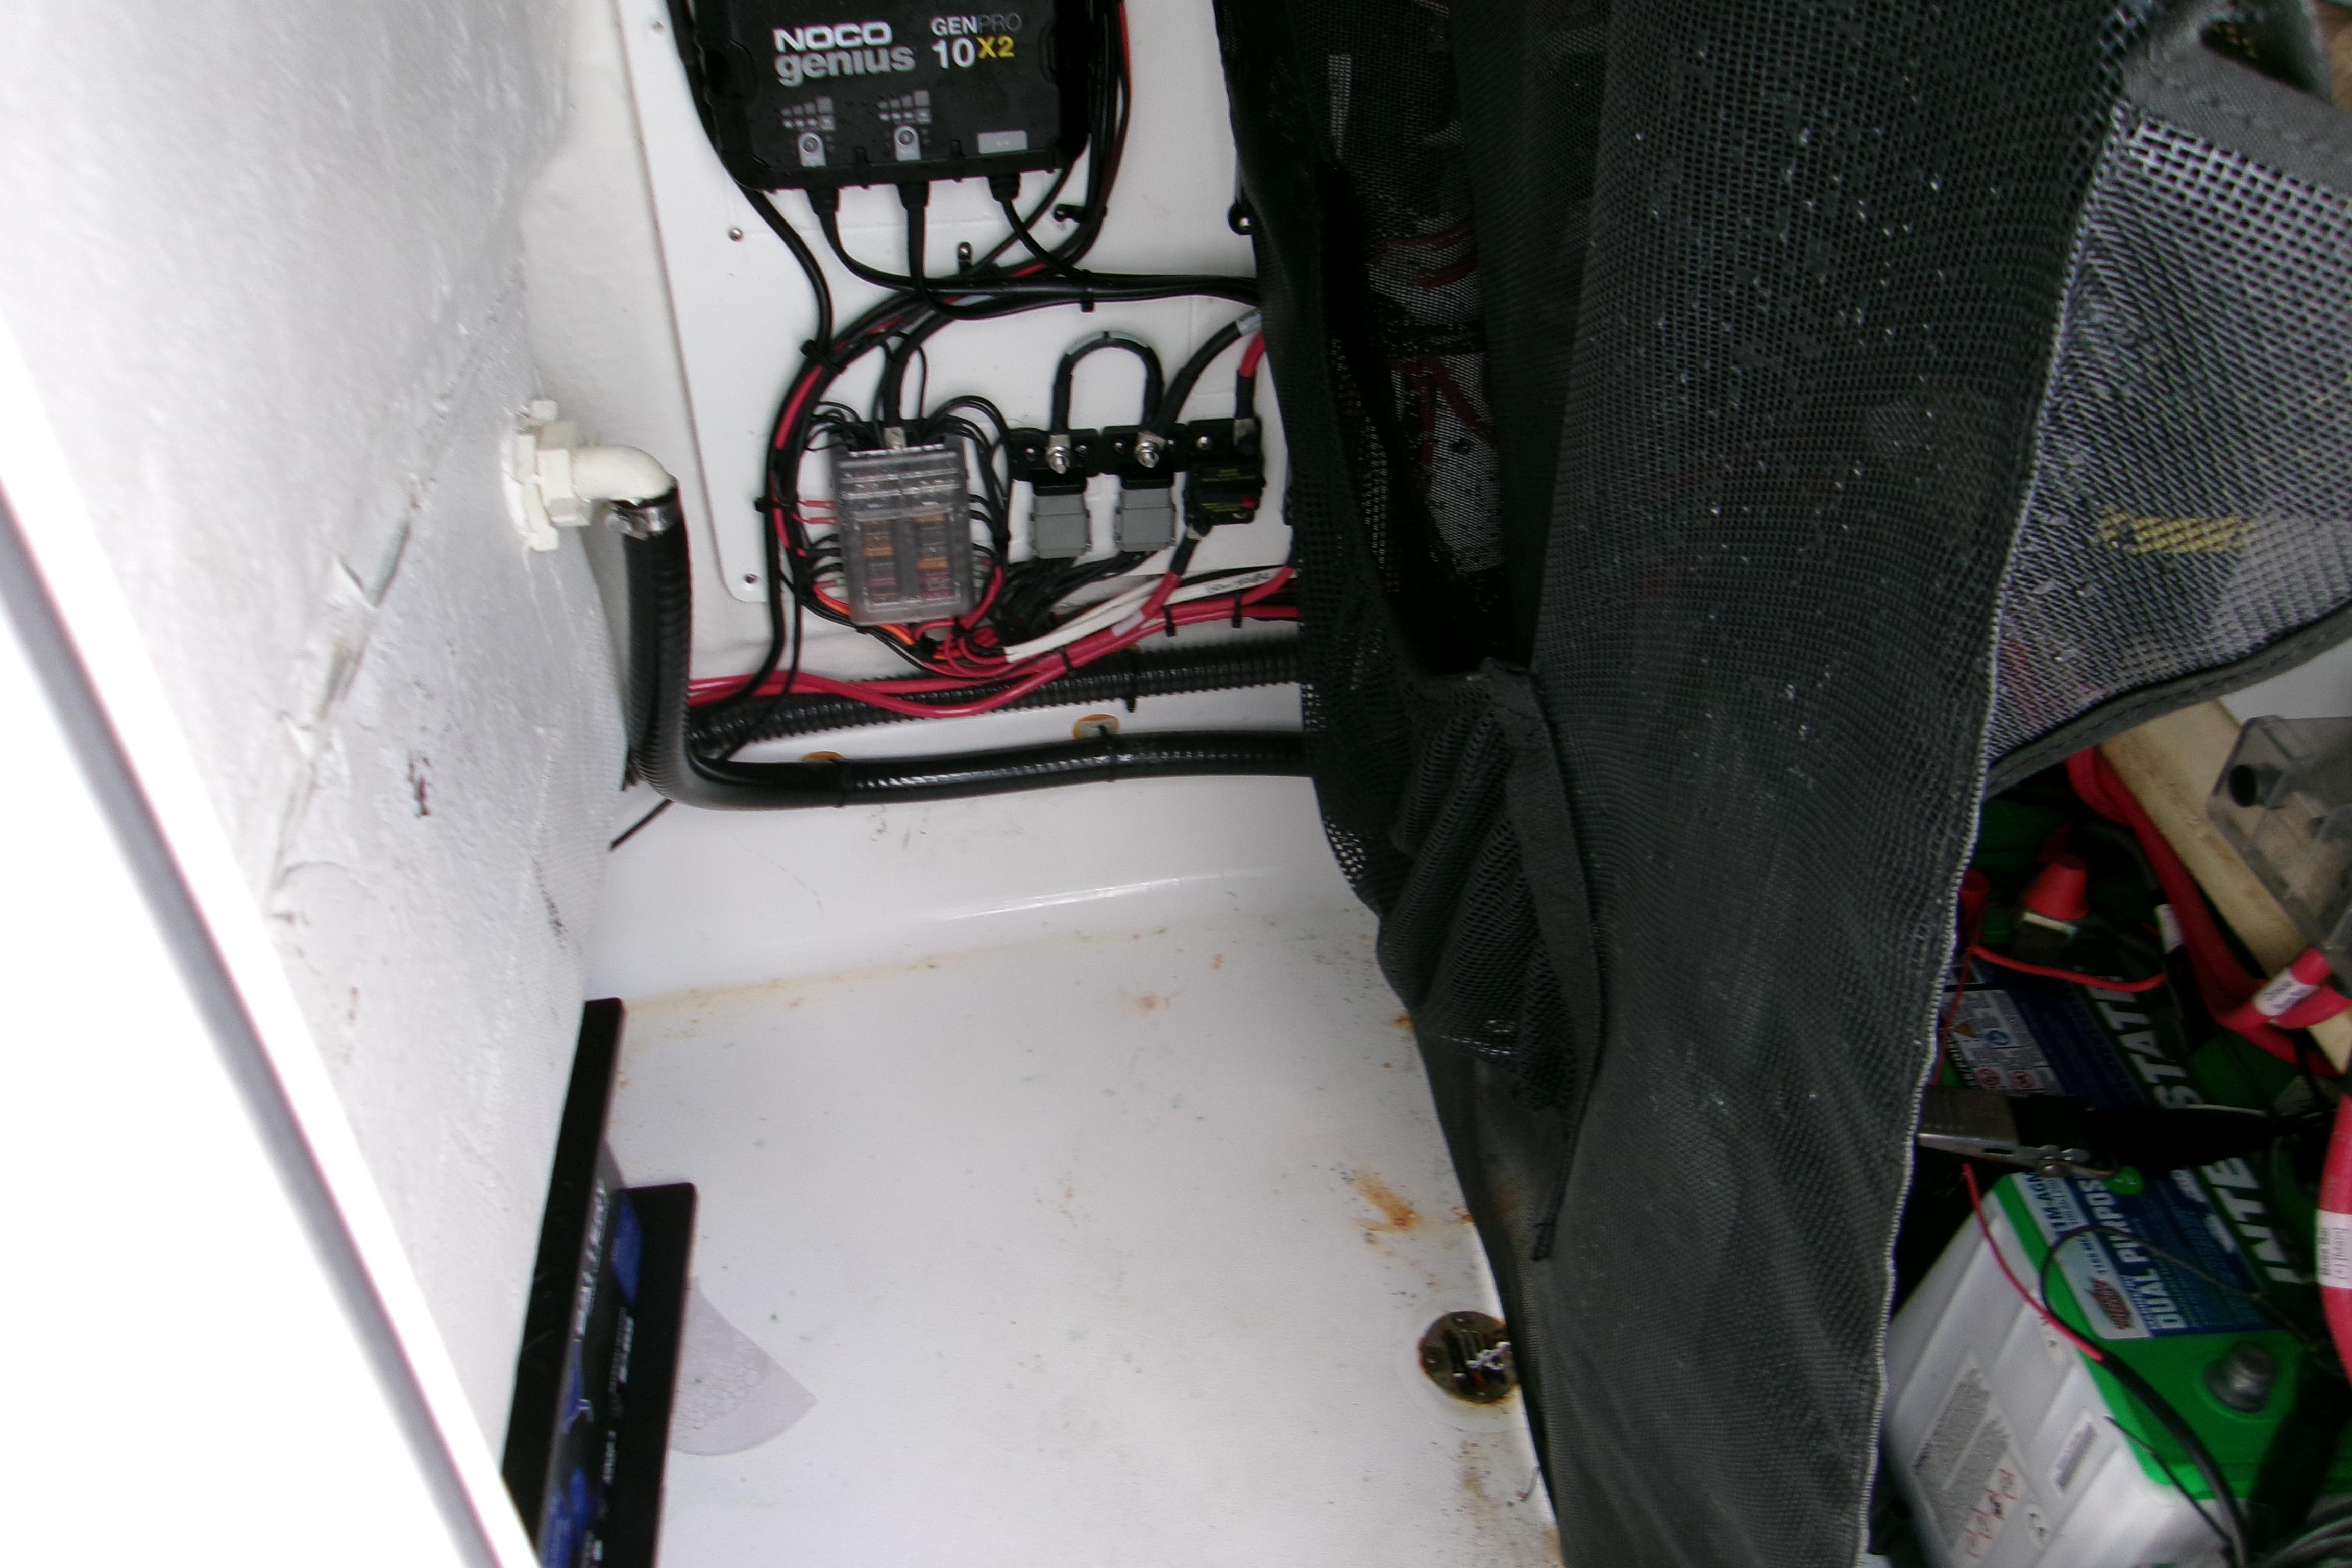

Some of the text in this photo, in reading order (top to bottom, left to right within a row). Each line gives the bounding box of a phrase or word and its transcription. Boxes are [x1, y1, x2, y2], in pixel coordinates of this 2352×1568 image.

[772, 21, 893, 52] NOCO
[774, 45, 916, 88] genius
[2133, 1267, 2189, 1328] DUAL
